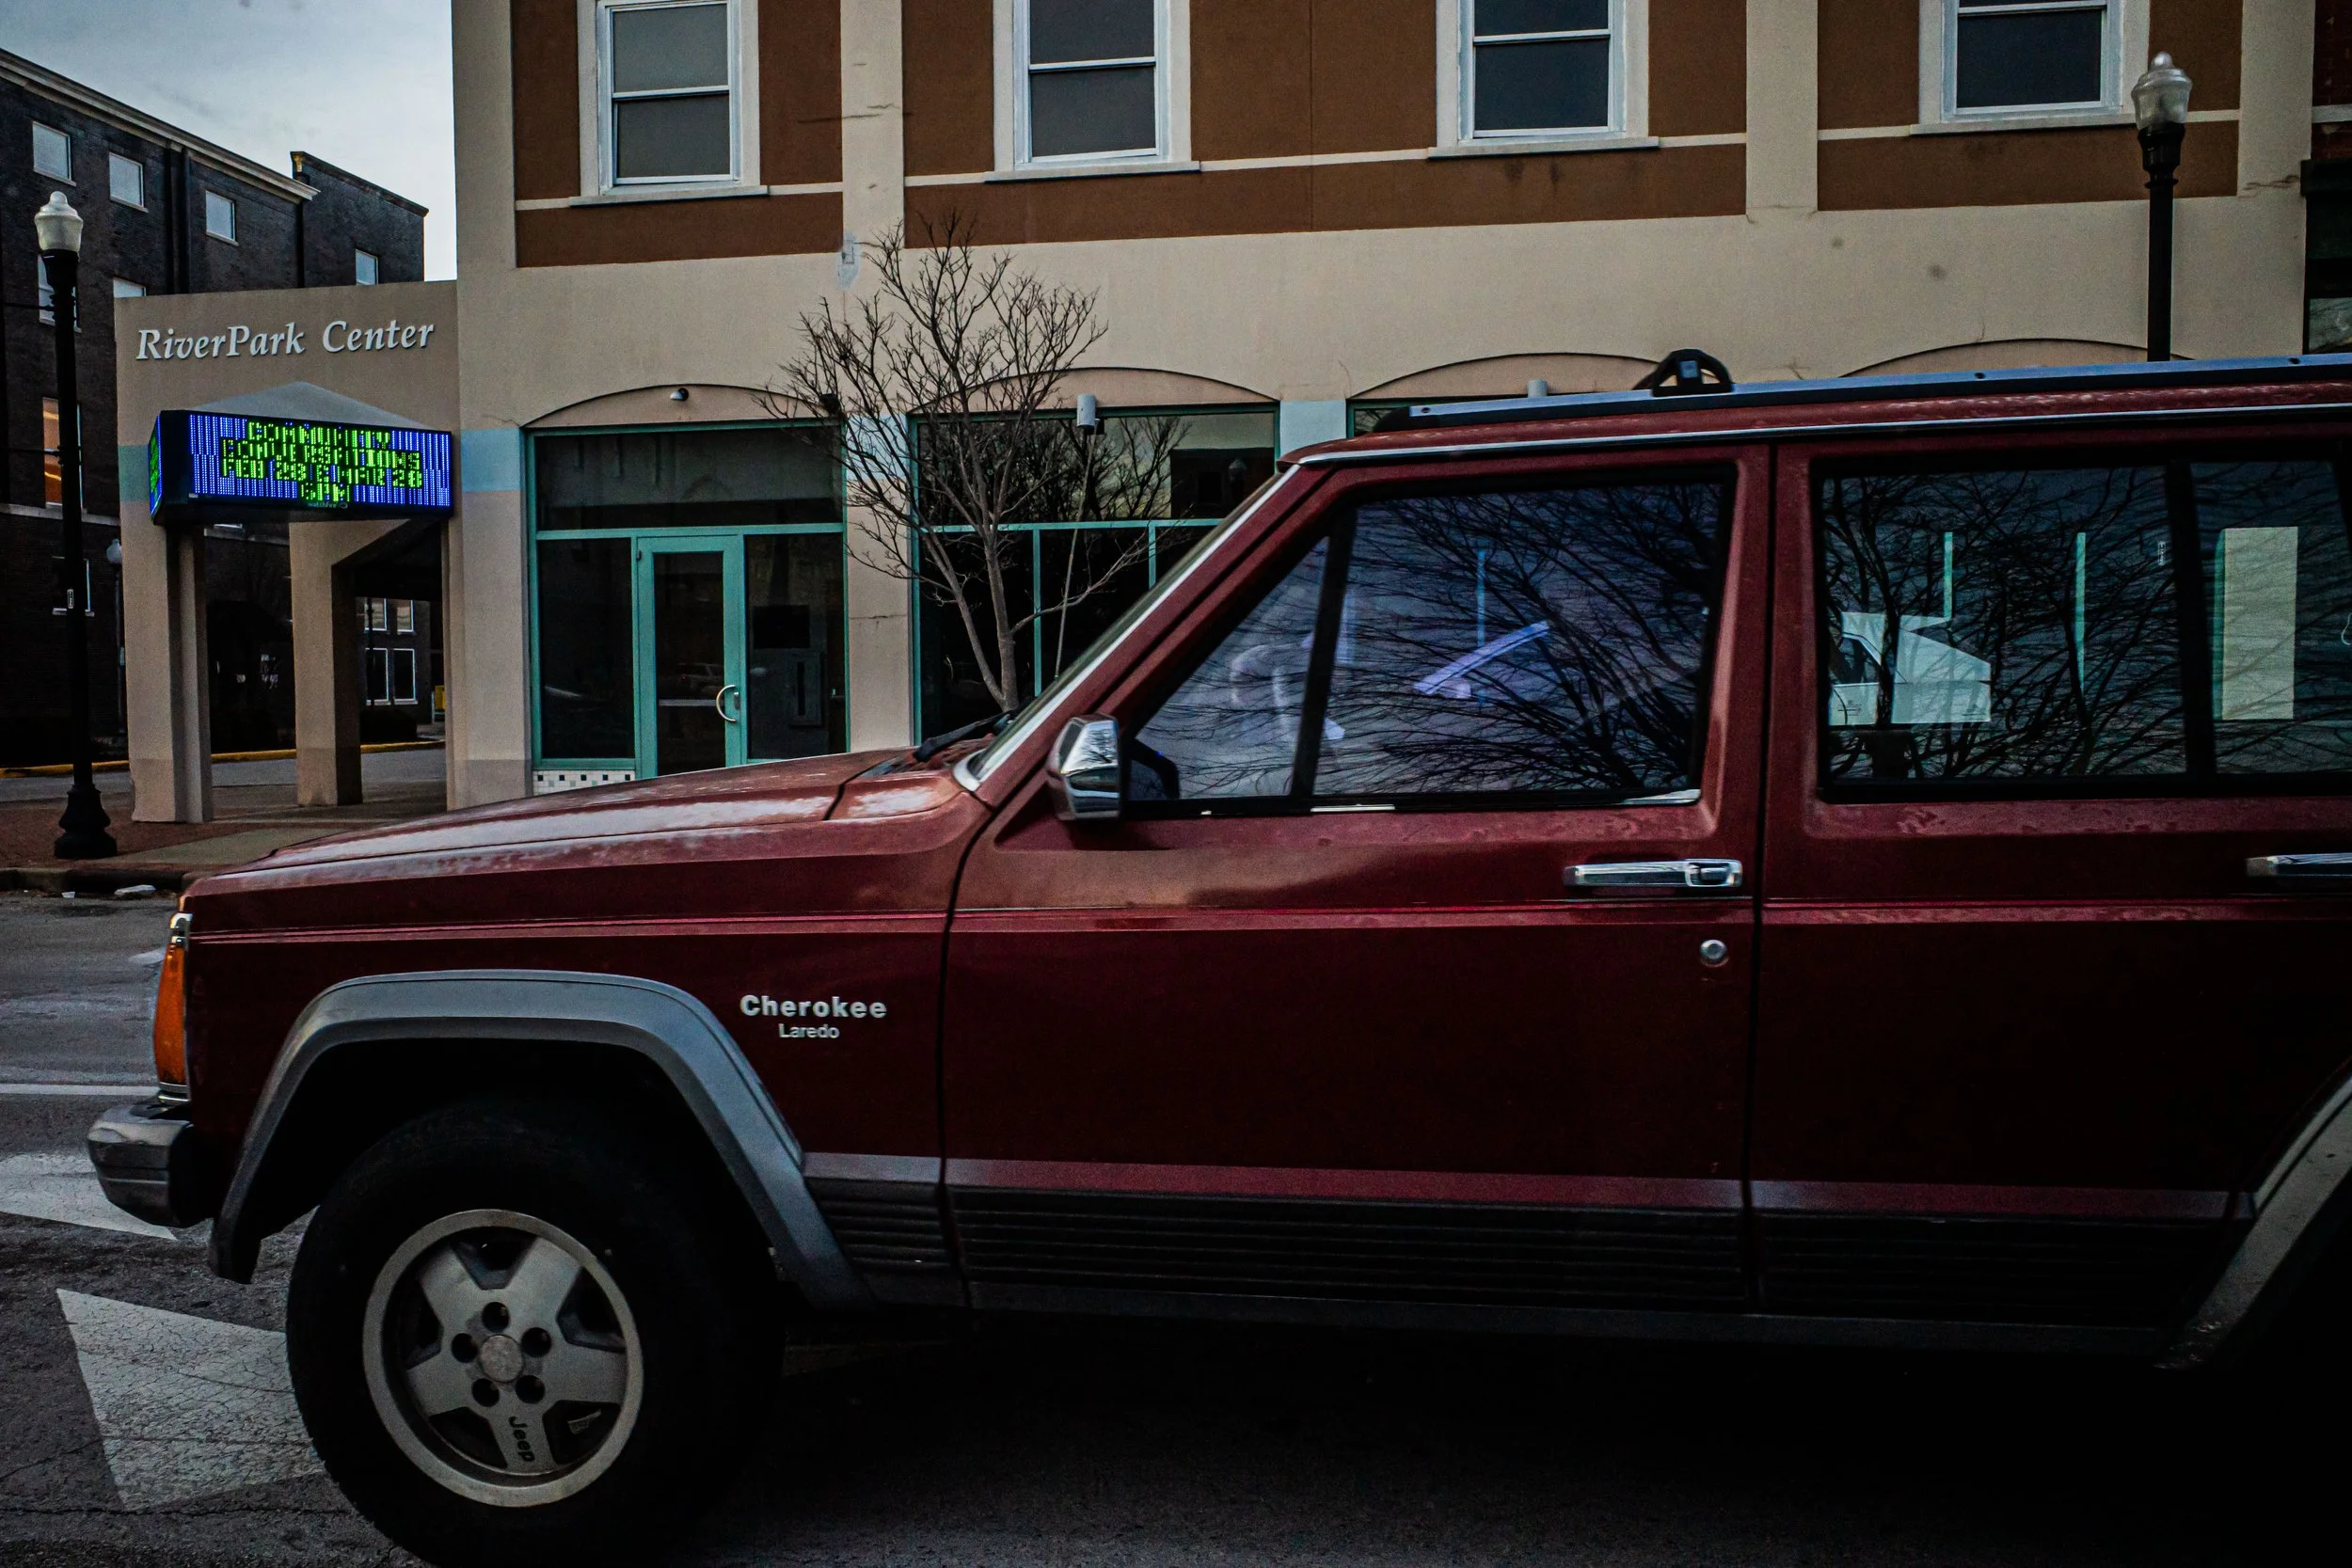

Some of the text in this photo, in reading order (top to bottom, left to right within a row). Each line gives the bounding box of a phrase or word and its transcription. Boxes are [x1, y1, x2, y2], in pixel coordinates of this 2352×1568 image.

[135, 320, 435, 360] RiverPark Center
[248, 421, 390, 450] COMMUNITY
[222, 458, 263, 479] FEB
[739, 994, 887, 1019] Cherokee
[778, 1023, 840, 1038] Laredo
[508, 1416, 535, 1462] Jeep
